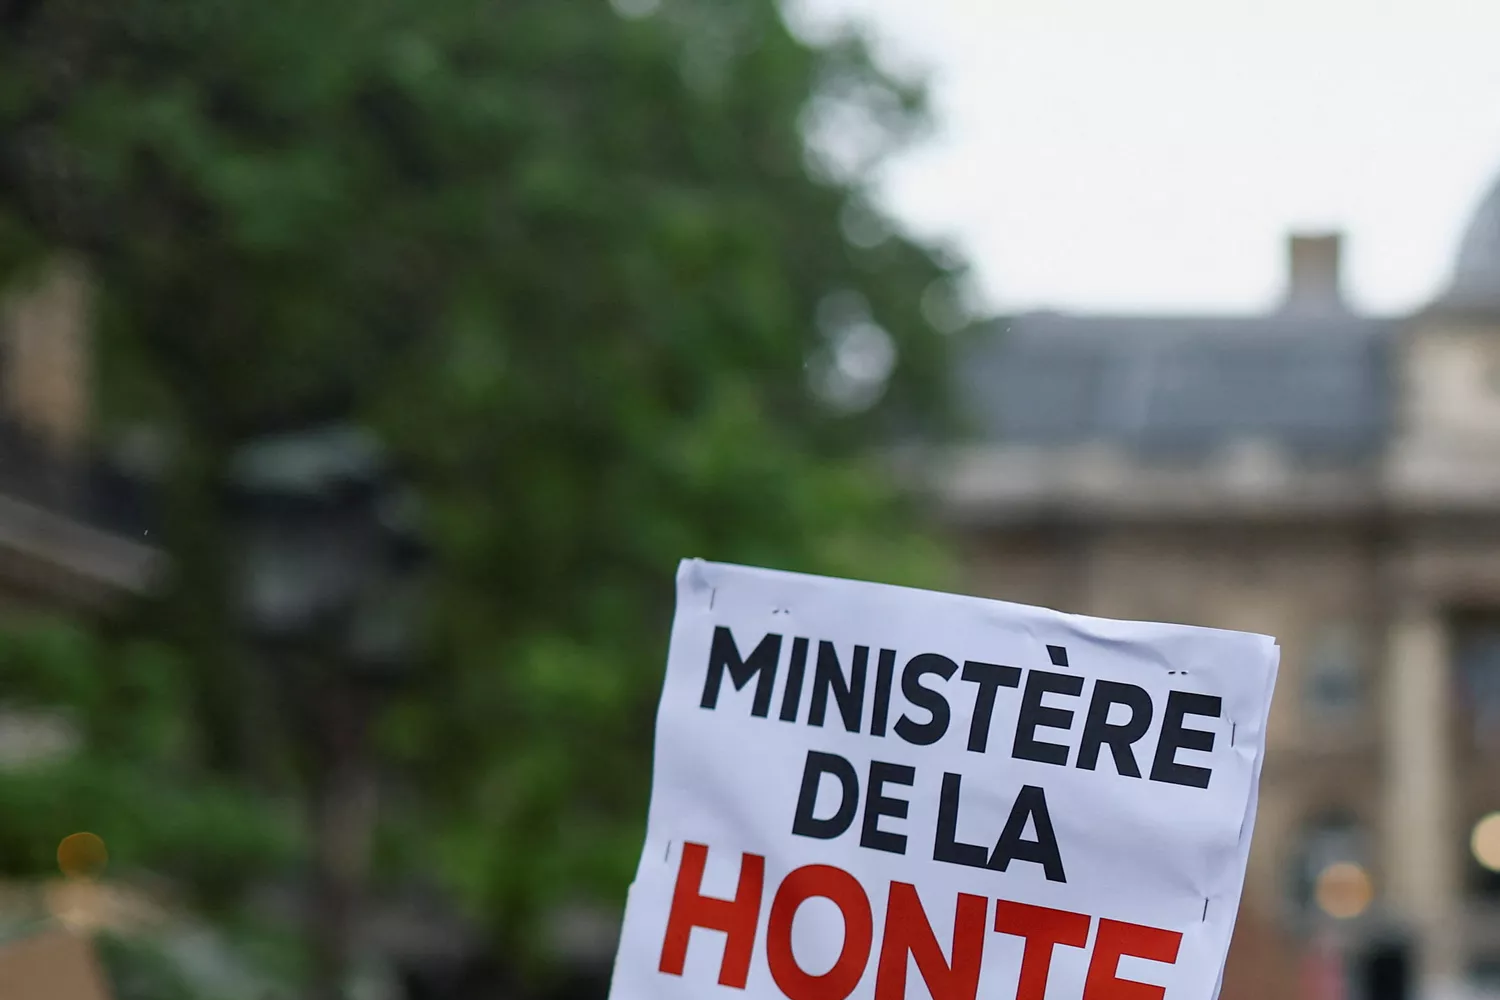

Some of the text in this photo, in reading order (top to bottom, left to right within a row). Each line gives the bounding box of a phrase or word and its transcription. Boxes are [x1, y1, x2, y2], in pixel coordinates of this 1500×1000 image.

[700, 626, 1222, 789] MINISTÈRE
[791, 750, 1067, 883] DE LA
